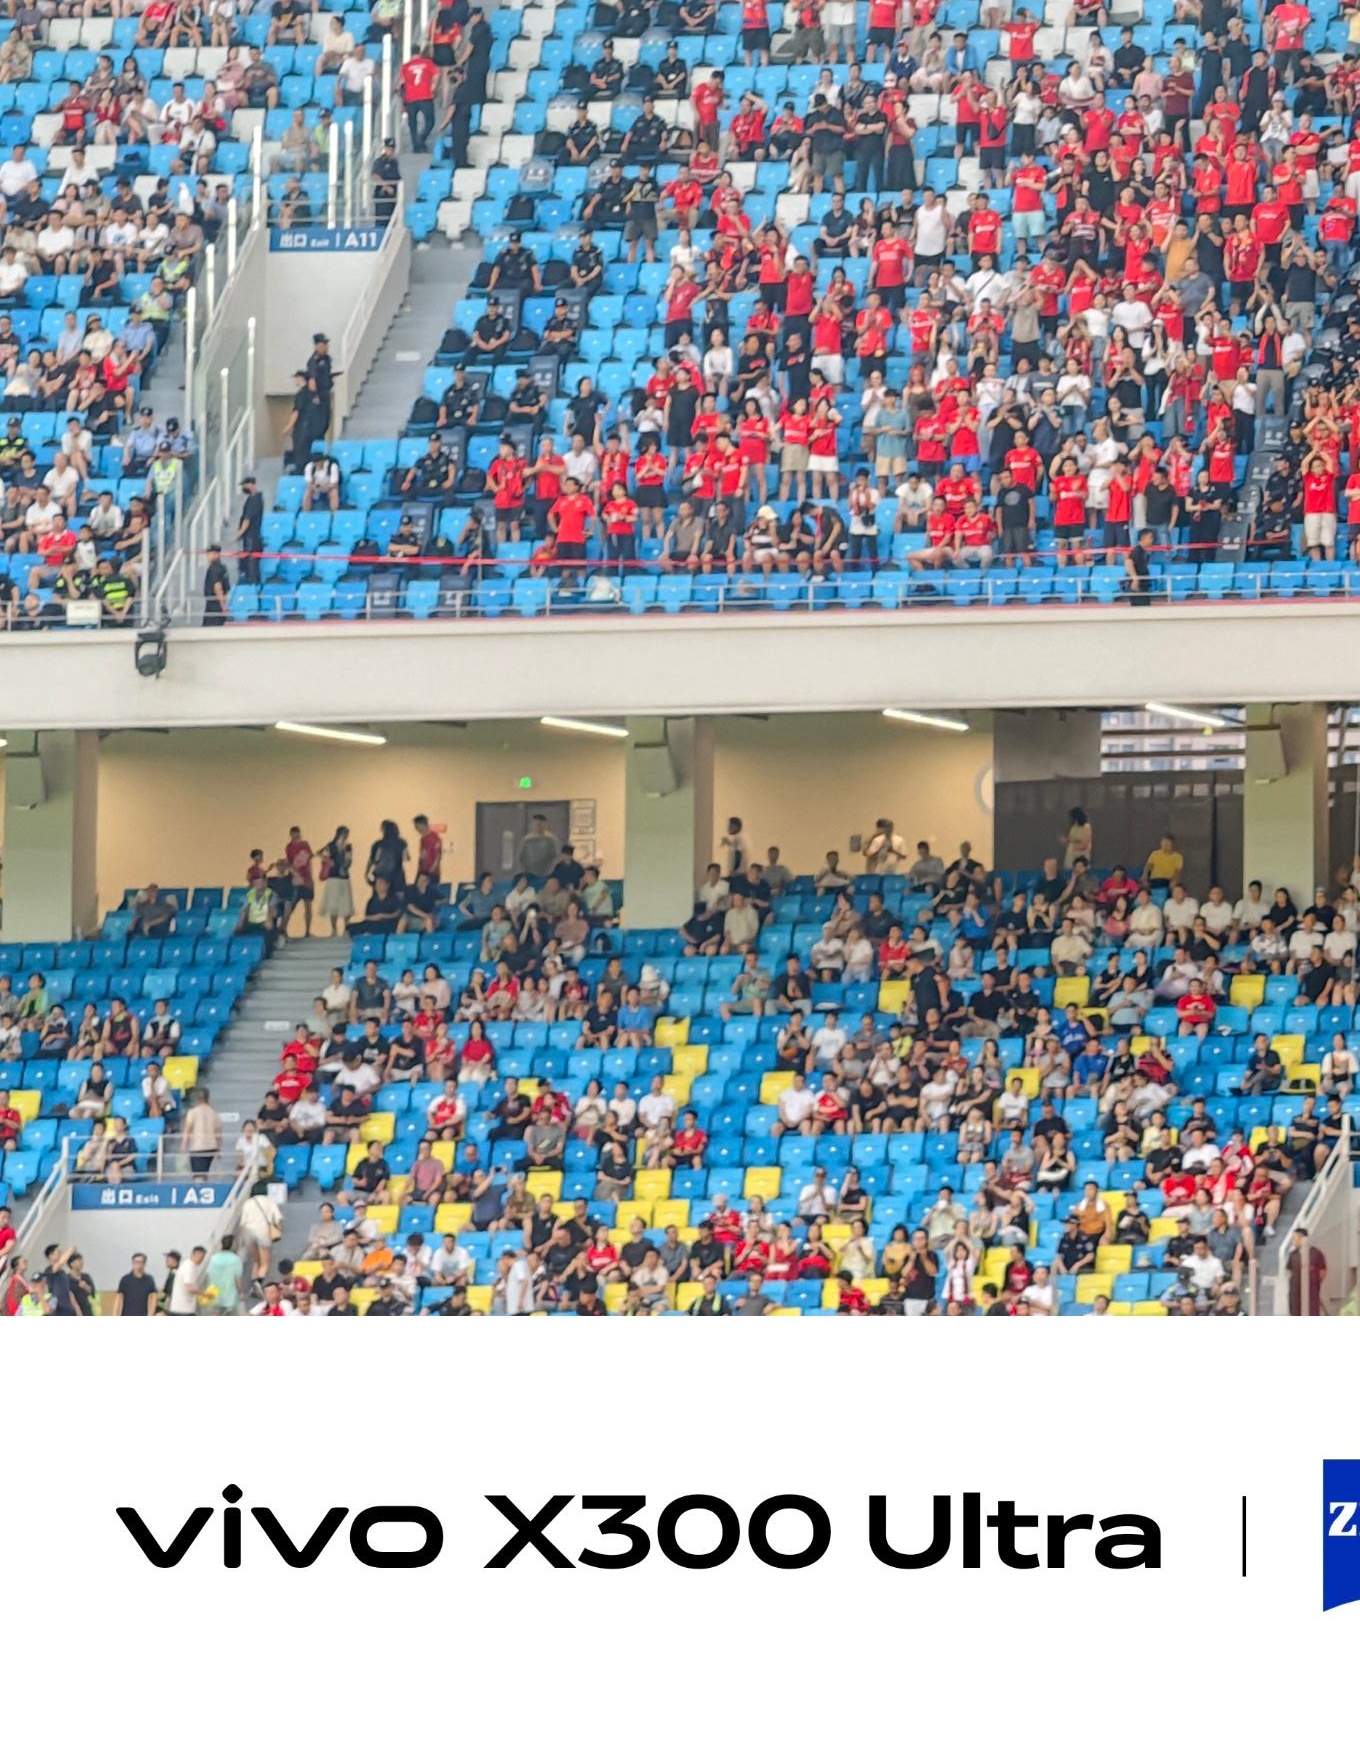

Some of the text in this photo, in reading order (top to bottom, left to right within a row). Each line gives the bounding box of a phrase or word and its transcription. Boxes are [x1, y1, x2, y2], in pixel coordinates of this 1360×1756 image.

[344, 231, 378, 248] A11
[101, 1188, 133, 1205] 出口
[183, 1187, 216, 1205] A3
